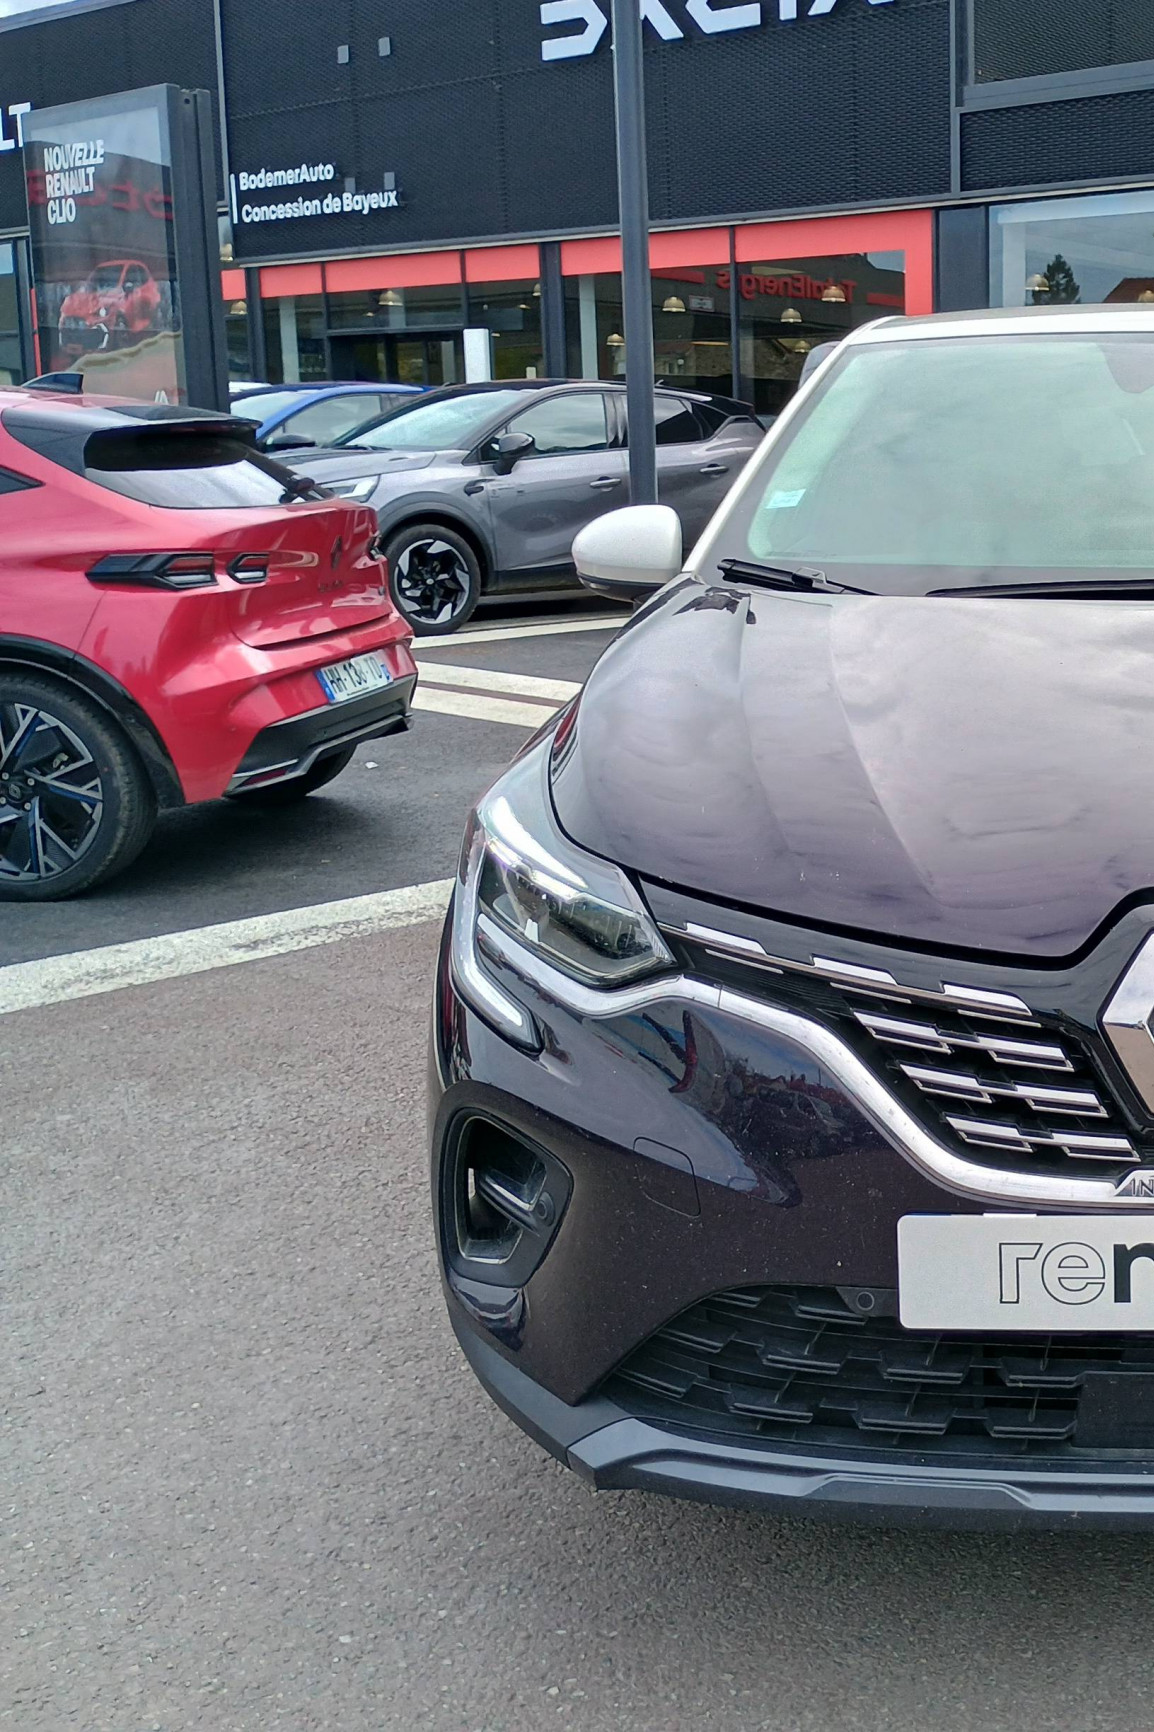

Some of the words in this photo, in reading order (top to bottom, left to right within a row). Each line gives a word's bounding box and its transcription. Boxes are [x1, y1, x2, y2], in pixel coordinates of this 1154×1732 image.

[44, 139, 105, 172] NOUVELLE
[45, 166, 95, 199] RENAULT
[239, 163, 334, 191] BodemerAuto
[47, 197, 76, 225] CLIO
[241, 197, 321, 223] Concession
[322, 193, 341, 214] de
[342, 190, 398, 215] Bayeux
